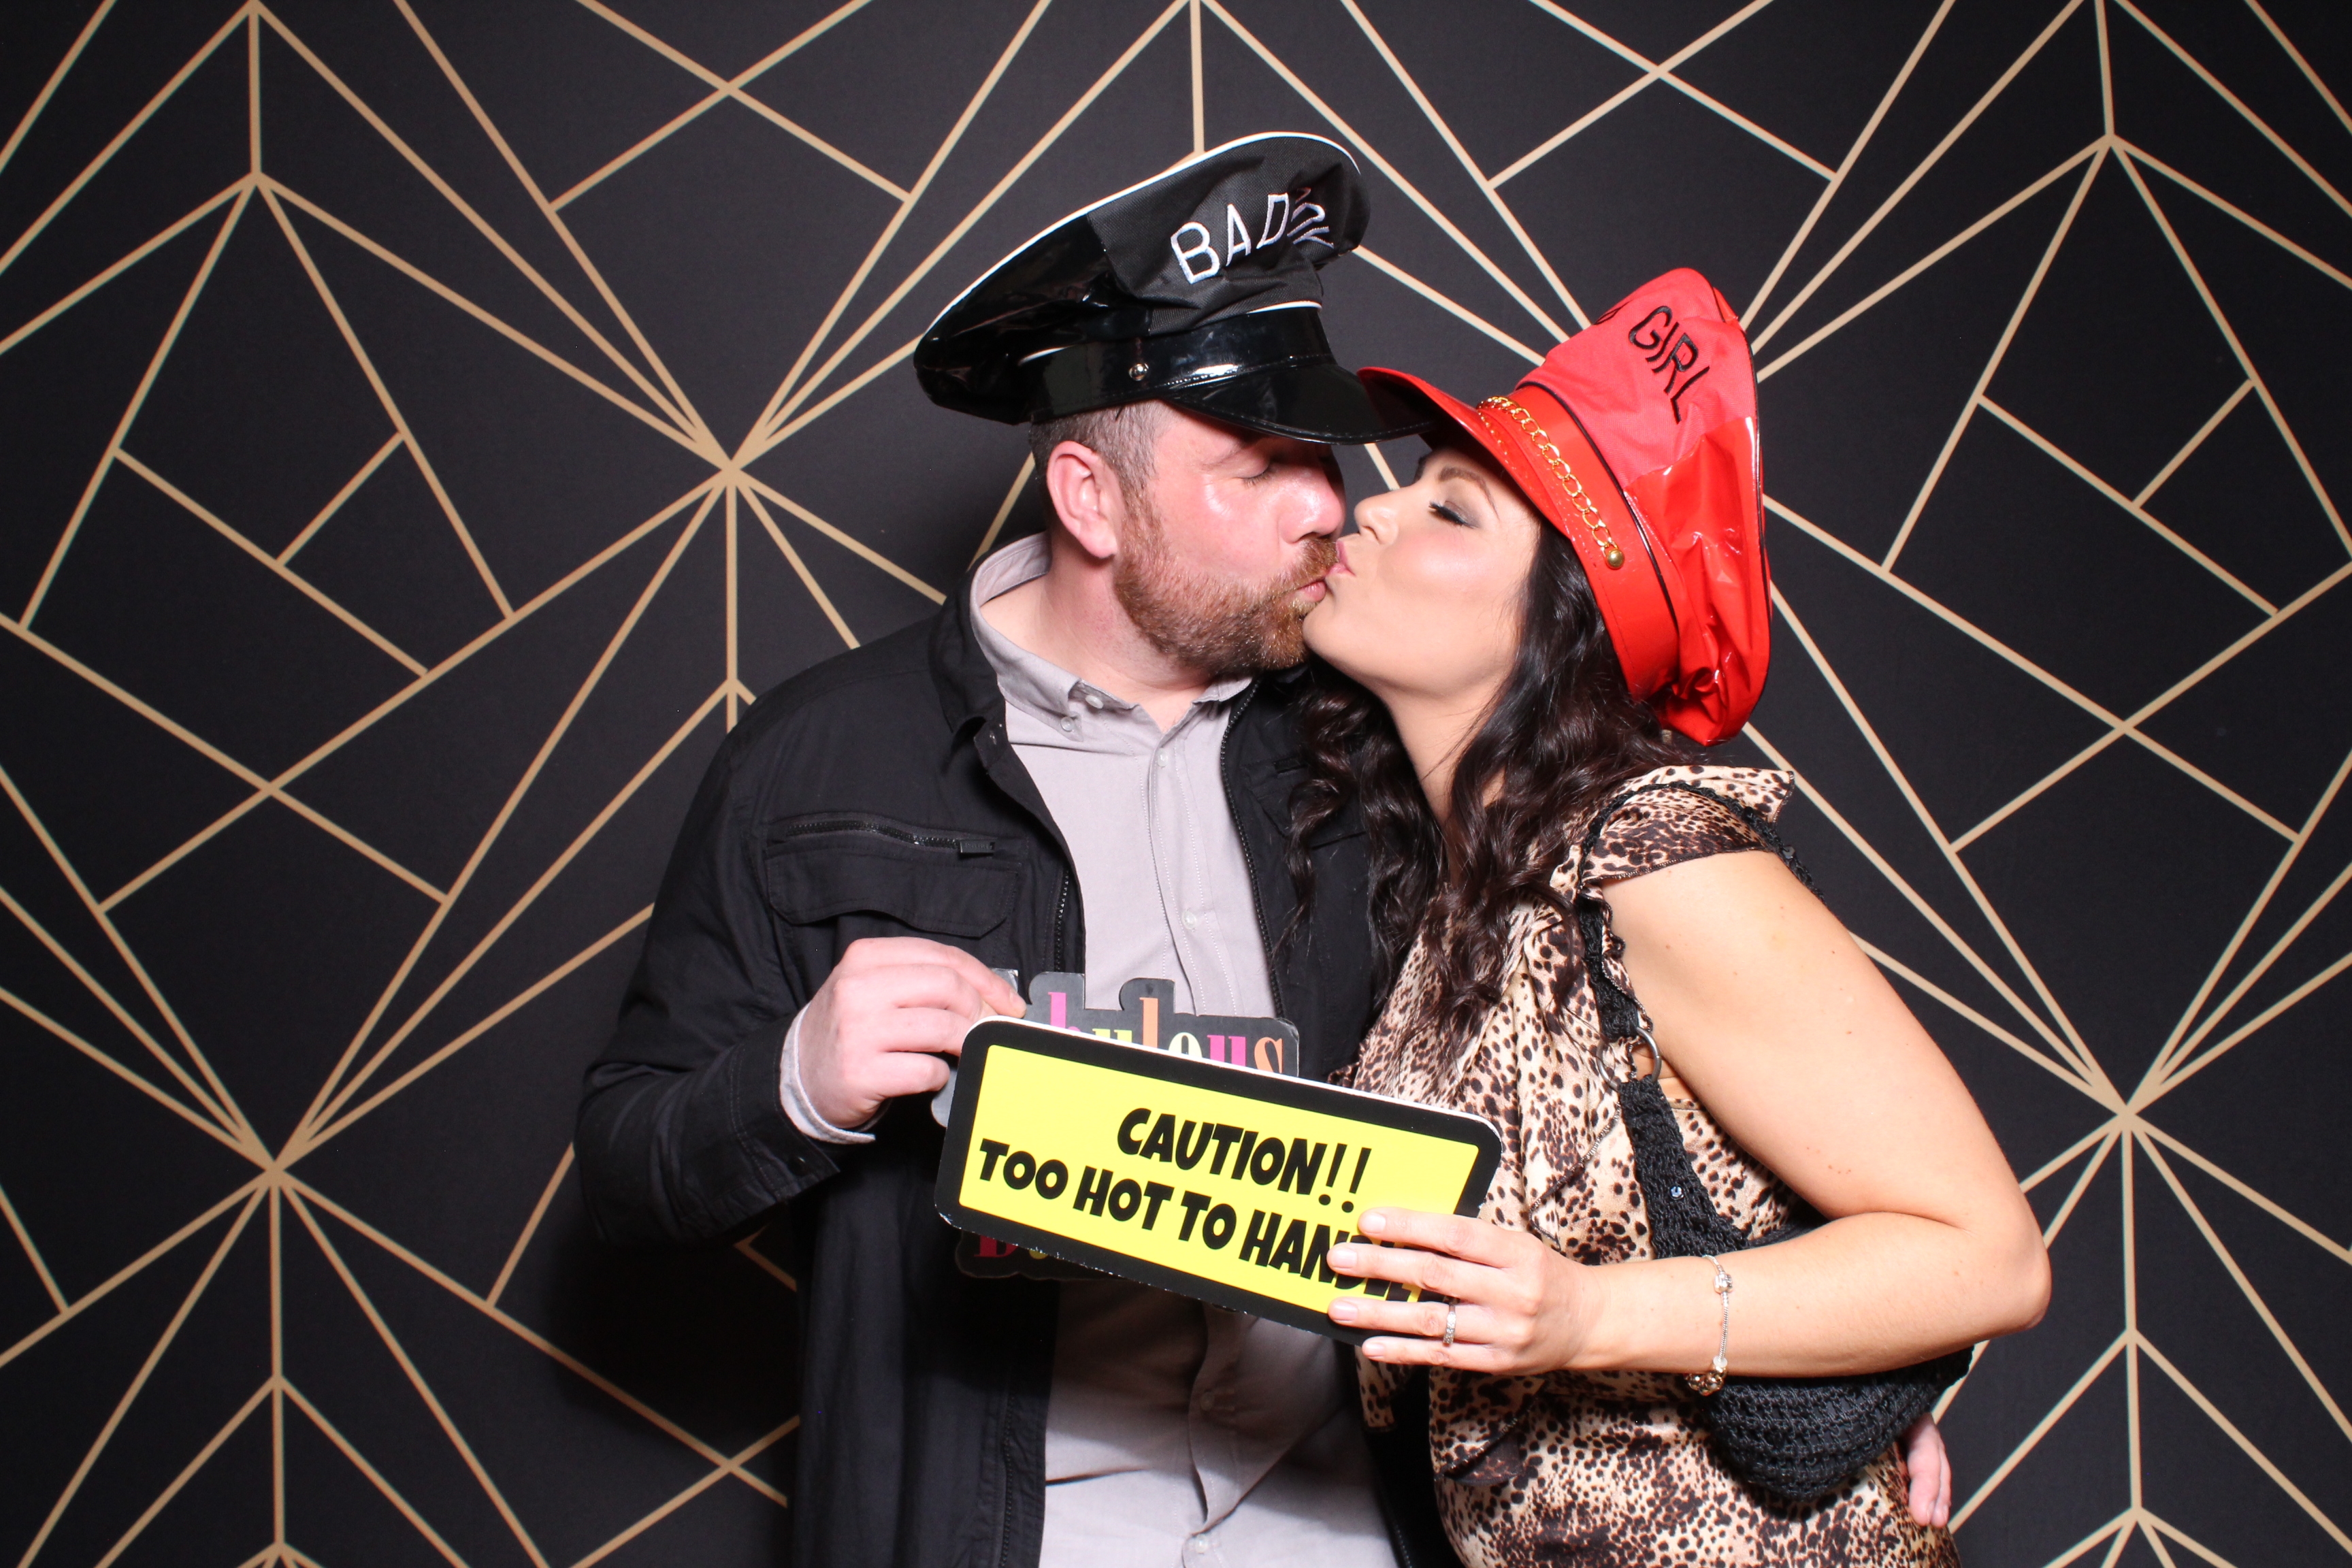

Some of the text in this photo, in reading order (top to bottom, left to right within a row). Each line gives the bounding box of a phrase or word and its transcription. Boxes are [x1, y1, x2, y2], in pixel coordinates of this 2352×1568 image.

[1170, 192, 1290, 284] BAD
[1629, 305, 1710, 425] GIRL
[979, 1138, 1069, 1200] TOO
[1073, 1165, 1175, 1230] HOT
[1178, 1190, 1237, 1250] TO
[1117, 1107, 1372, 1213] CAUTION!!
